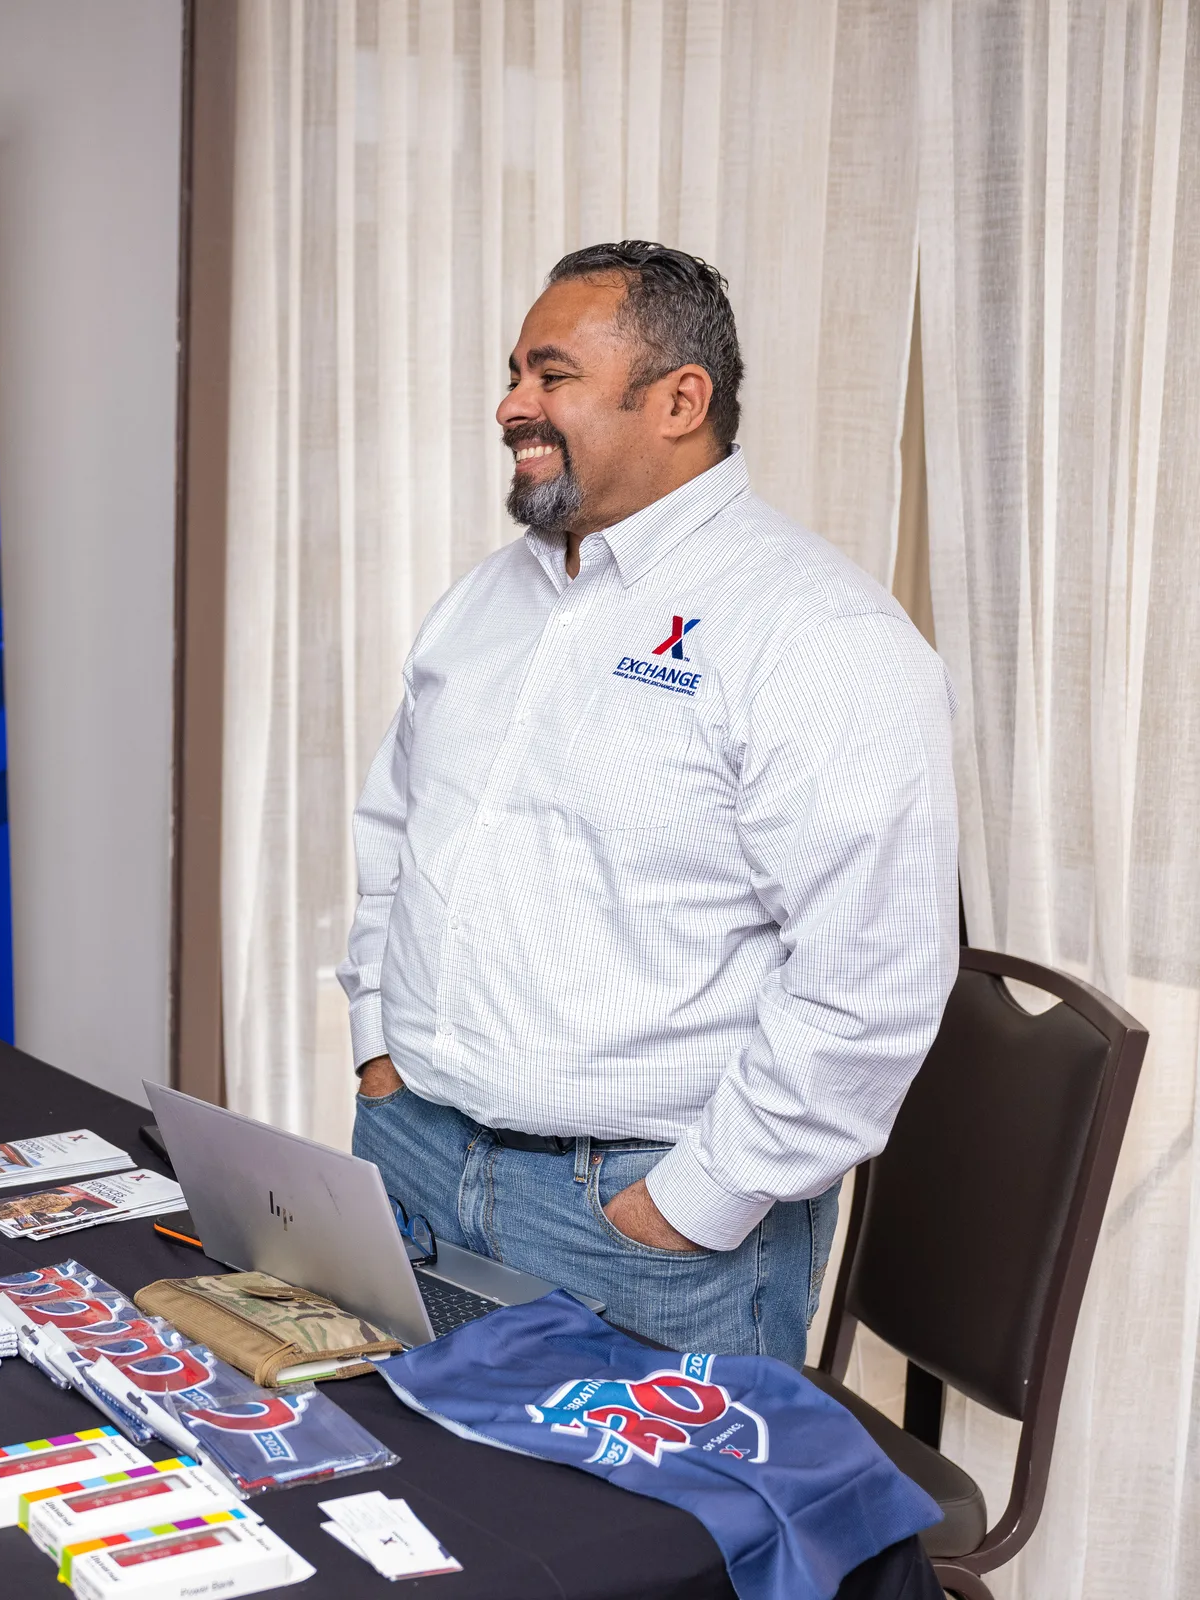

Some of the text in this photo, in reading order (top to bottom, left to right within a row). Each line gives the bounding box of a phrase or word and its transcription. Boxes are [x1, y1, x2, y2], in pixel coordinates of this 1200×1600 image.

[616, 656, 702, 690] EXCHANGE
[261, 1434, 286, 1456] 2025
[598, 1442, 624, 1465] 895
